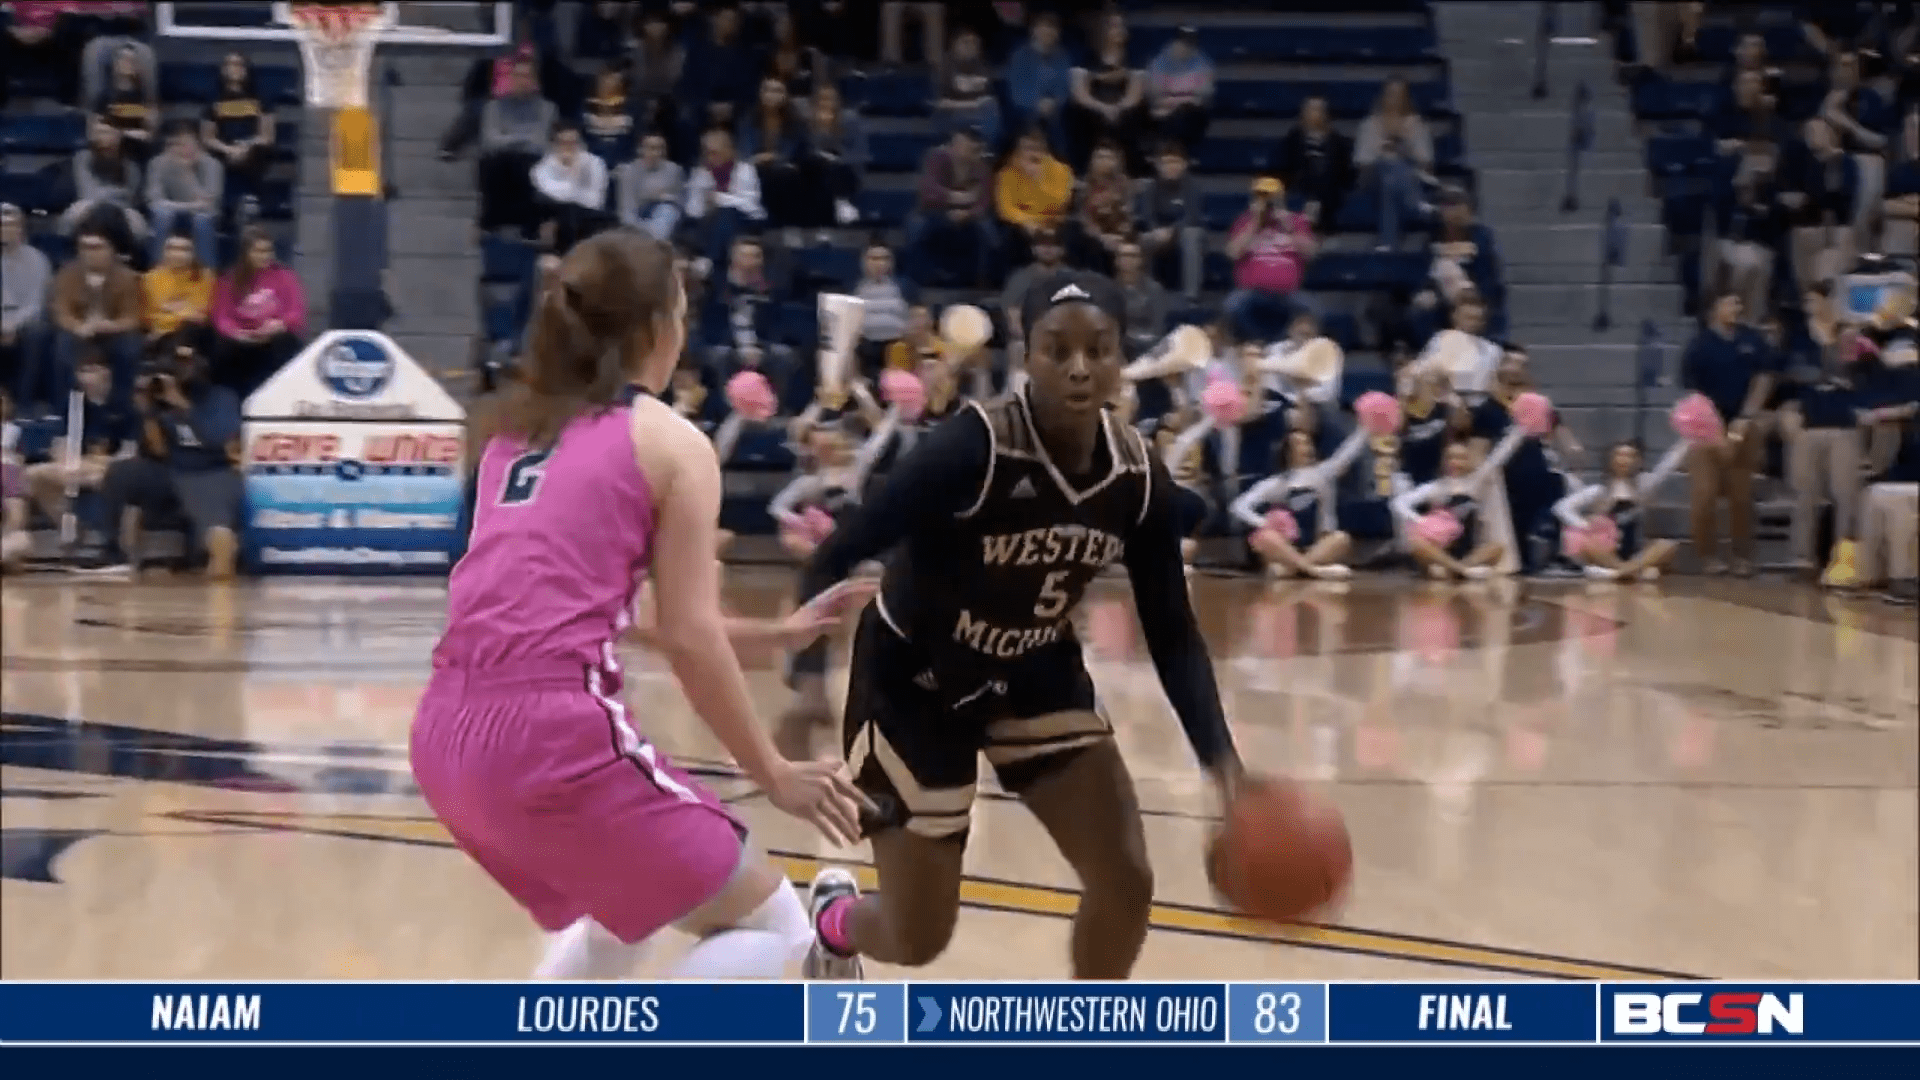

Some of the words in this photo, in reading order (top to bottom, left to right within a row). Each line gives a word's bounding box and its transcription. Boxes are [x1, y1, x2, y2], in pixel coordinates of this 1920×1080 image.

[498, 451, 546, 506] 2
[982, 524, 1125, 567] WESTER
[1033, 570, 1070, 618] 5
